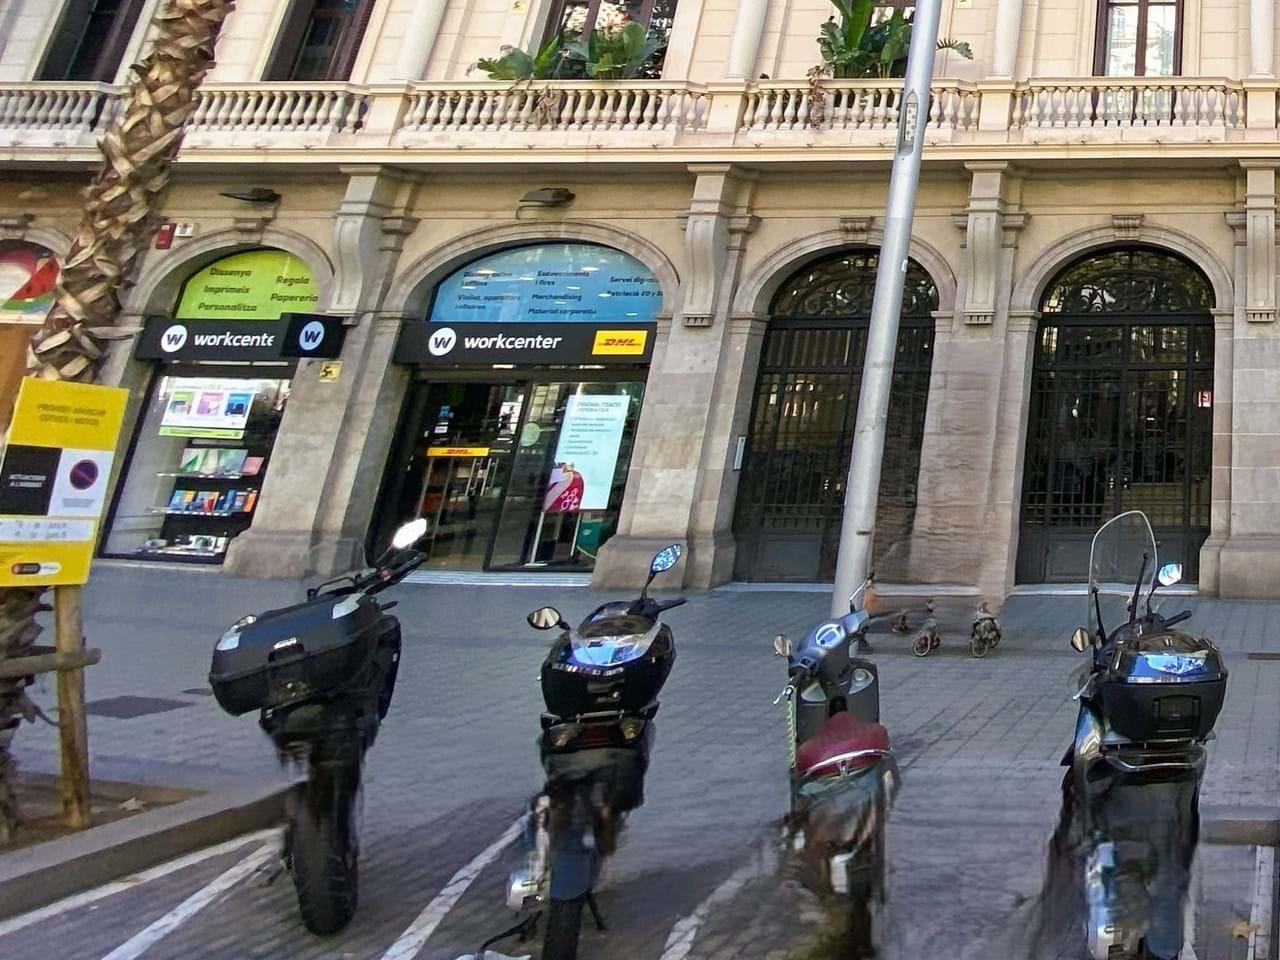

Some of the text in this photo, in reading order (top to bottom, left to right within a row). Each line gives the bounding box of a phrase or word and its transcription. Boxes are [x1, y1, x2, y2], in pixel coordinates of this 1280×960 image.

[276, 276, 310, 287] Regala
[203, 285, 251, 295] Imprimeix
[270, 292, 319, 303] Papereria
[198, 302, 258, 312] Personalitza
[194, 331, 275, 348] workcente
[463, 333, 562, 349] workcenter
[602, 337, 637, 347] DHL
